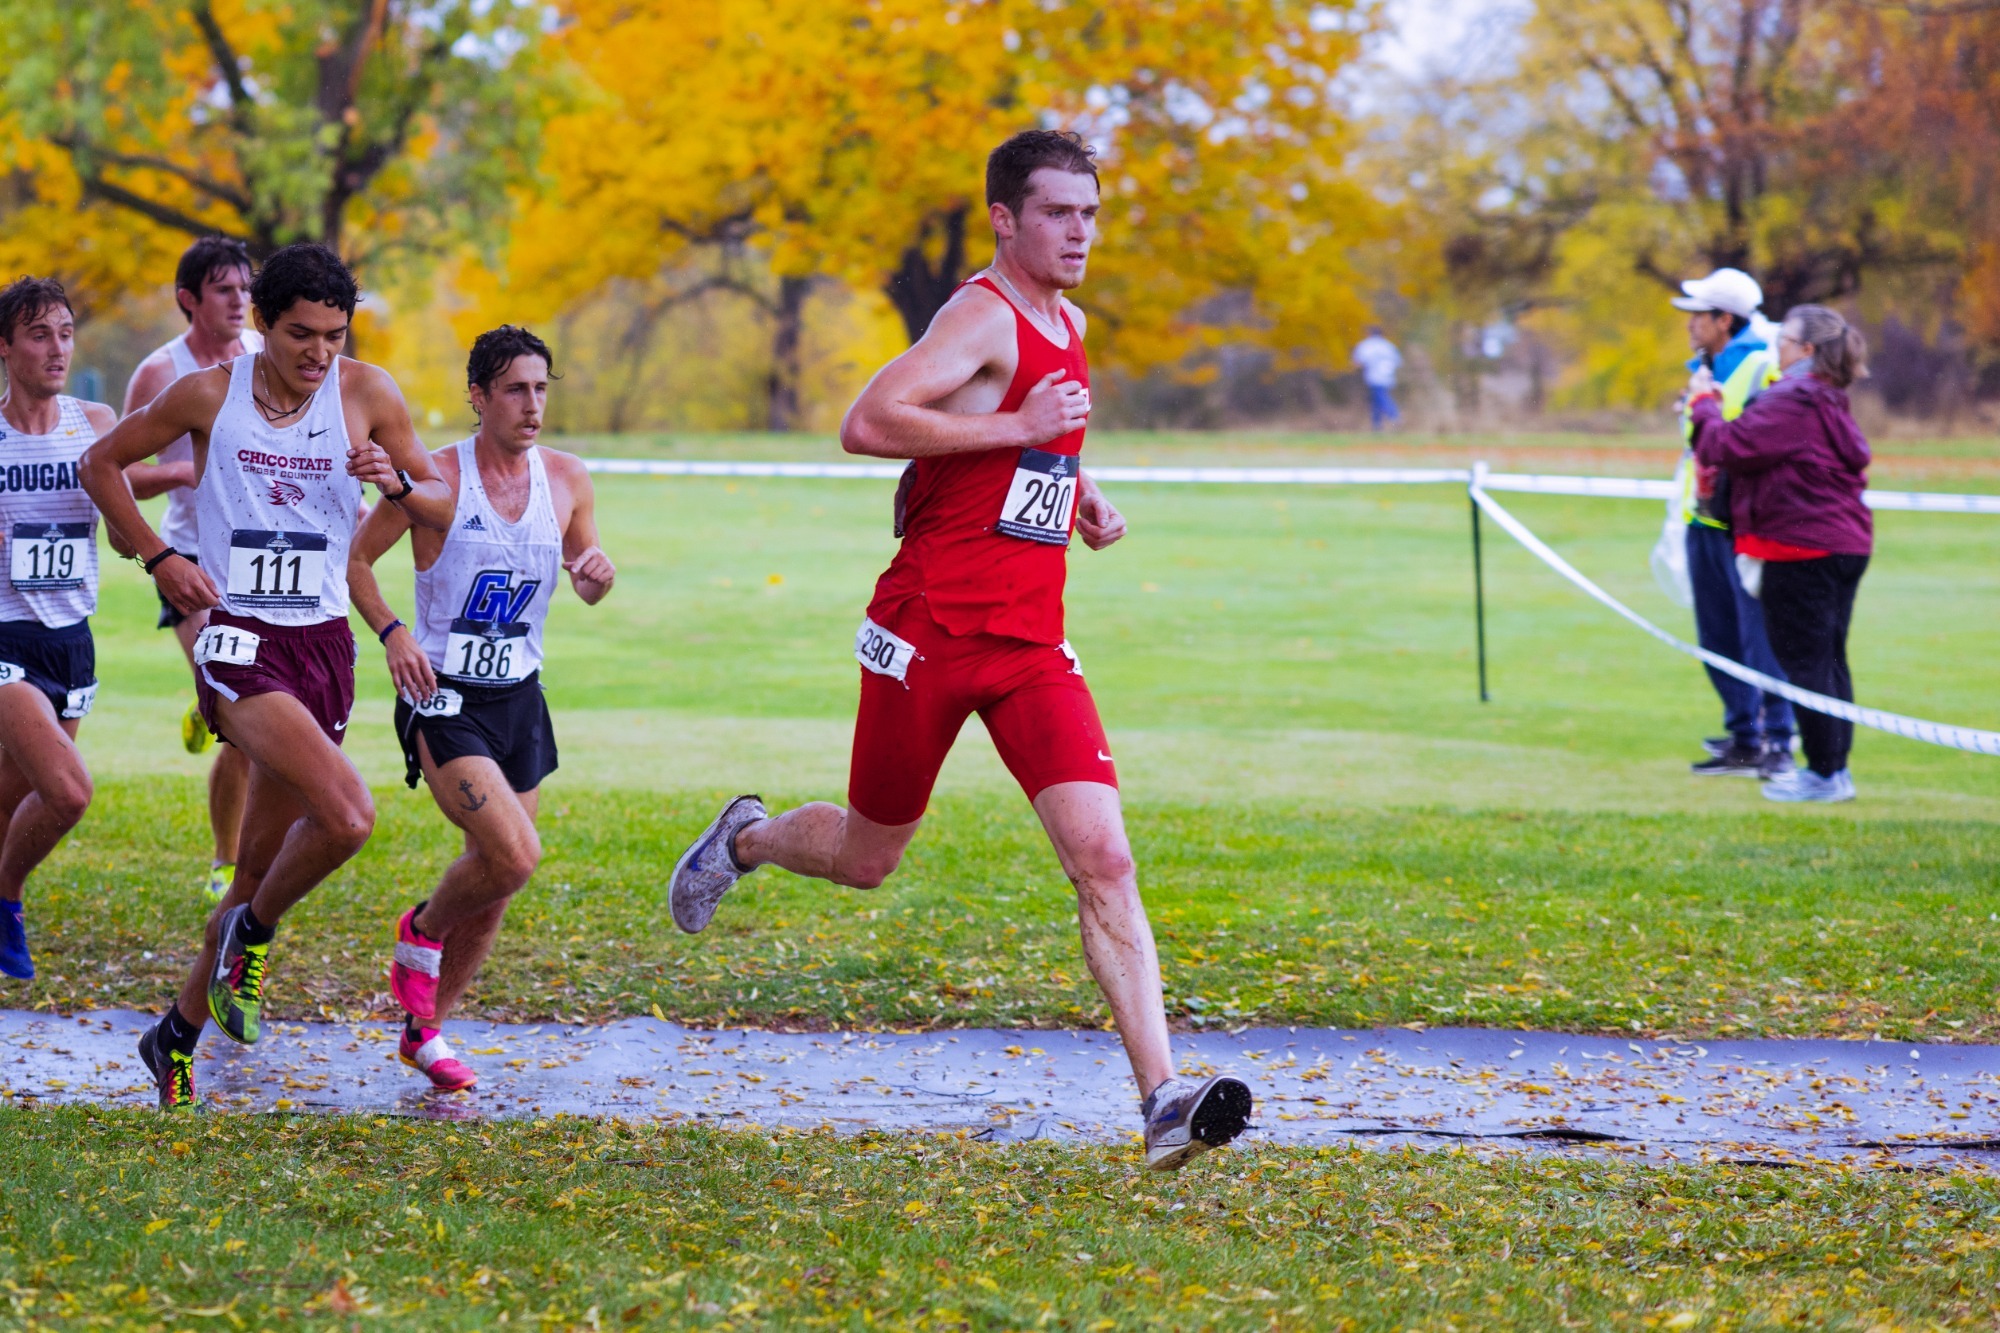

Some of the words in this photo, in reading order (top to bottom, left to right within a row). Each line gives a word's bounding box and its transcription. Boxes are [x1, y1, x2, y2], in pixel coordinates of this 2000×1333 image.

[242, 465, 276, 476] CROSS
[280, 470, 328, 481] COUNTRY
[1015, 478, 1071, 529] 290
[28, 544, 74, 579] 119
[250, 555, 302, 595] 111
[461, 570, 541, 623] GV
[203, 633, 240, 656] 111
[458, 640, 512, 679] 186
[861, 628, 896, 669] 290
